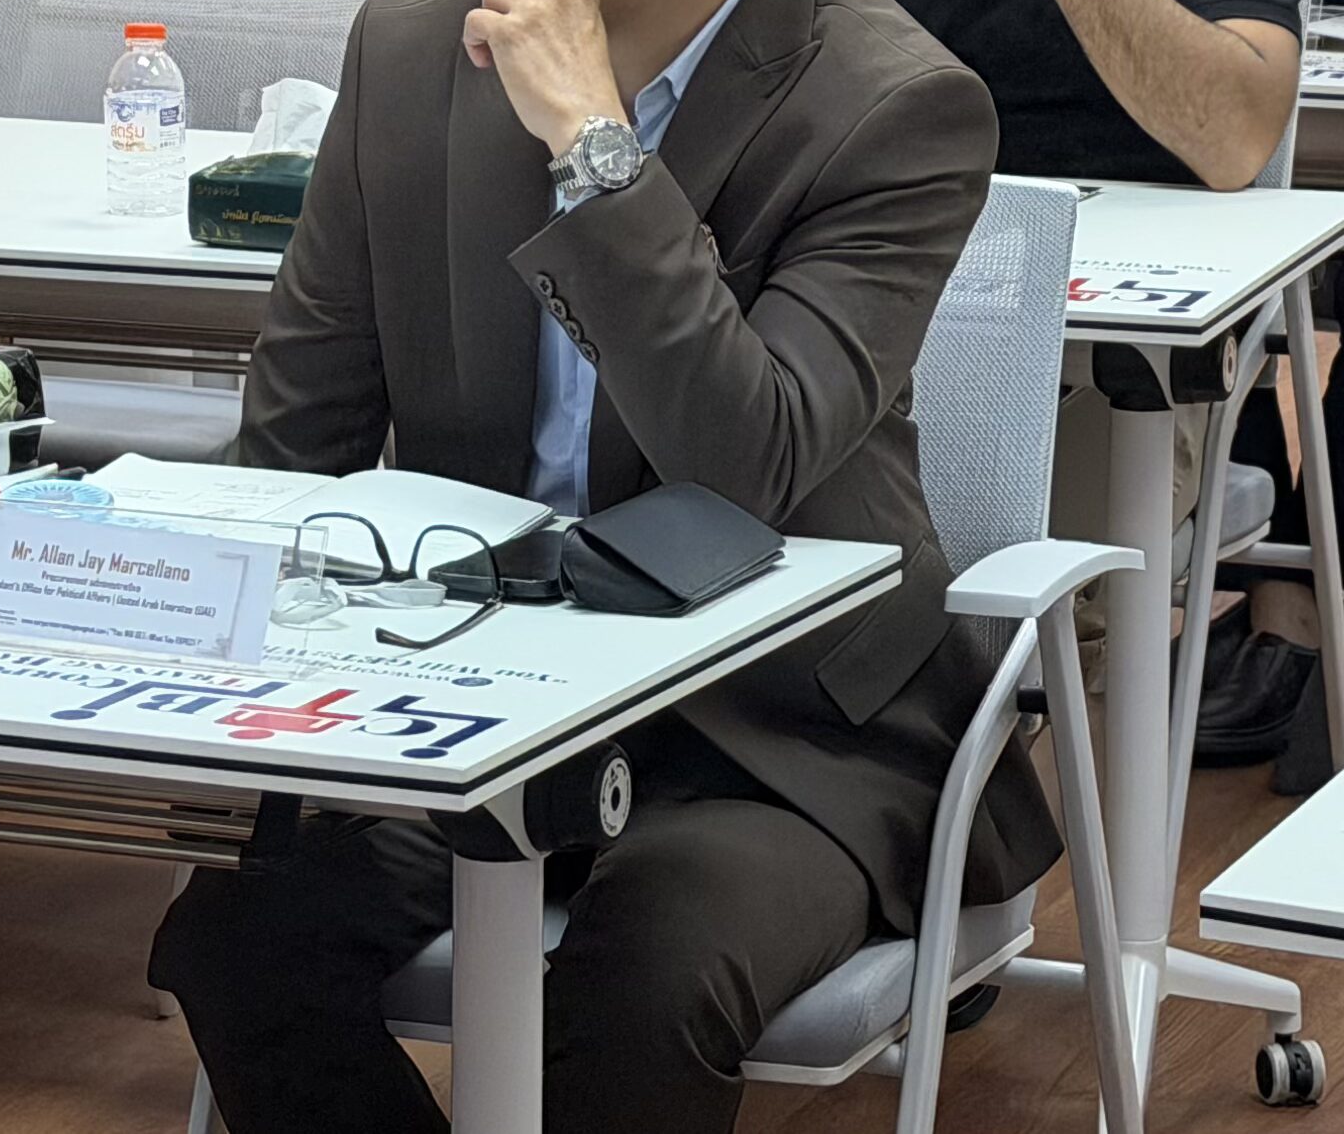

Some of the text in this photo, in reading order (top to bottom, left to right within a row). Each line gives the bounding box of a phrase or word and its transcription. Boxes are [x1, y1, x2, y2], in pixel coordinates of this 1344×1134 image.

[11, 539, 190, 582] Mr. Allan Jay Marcellano
